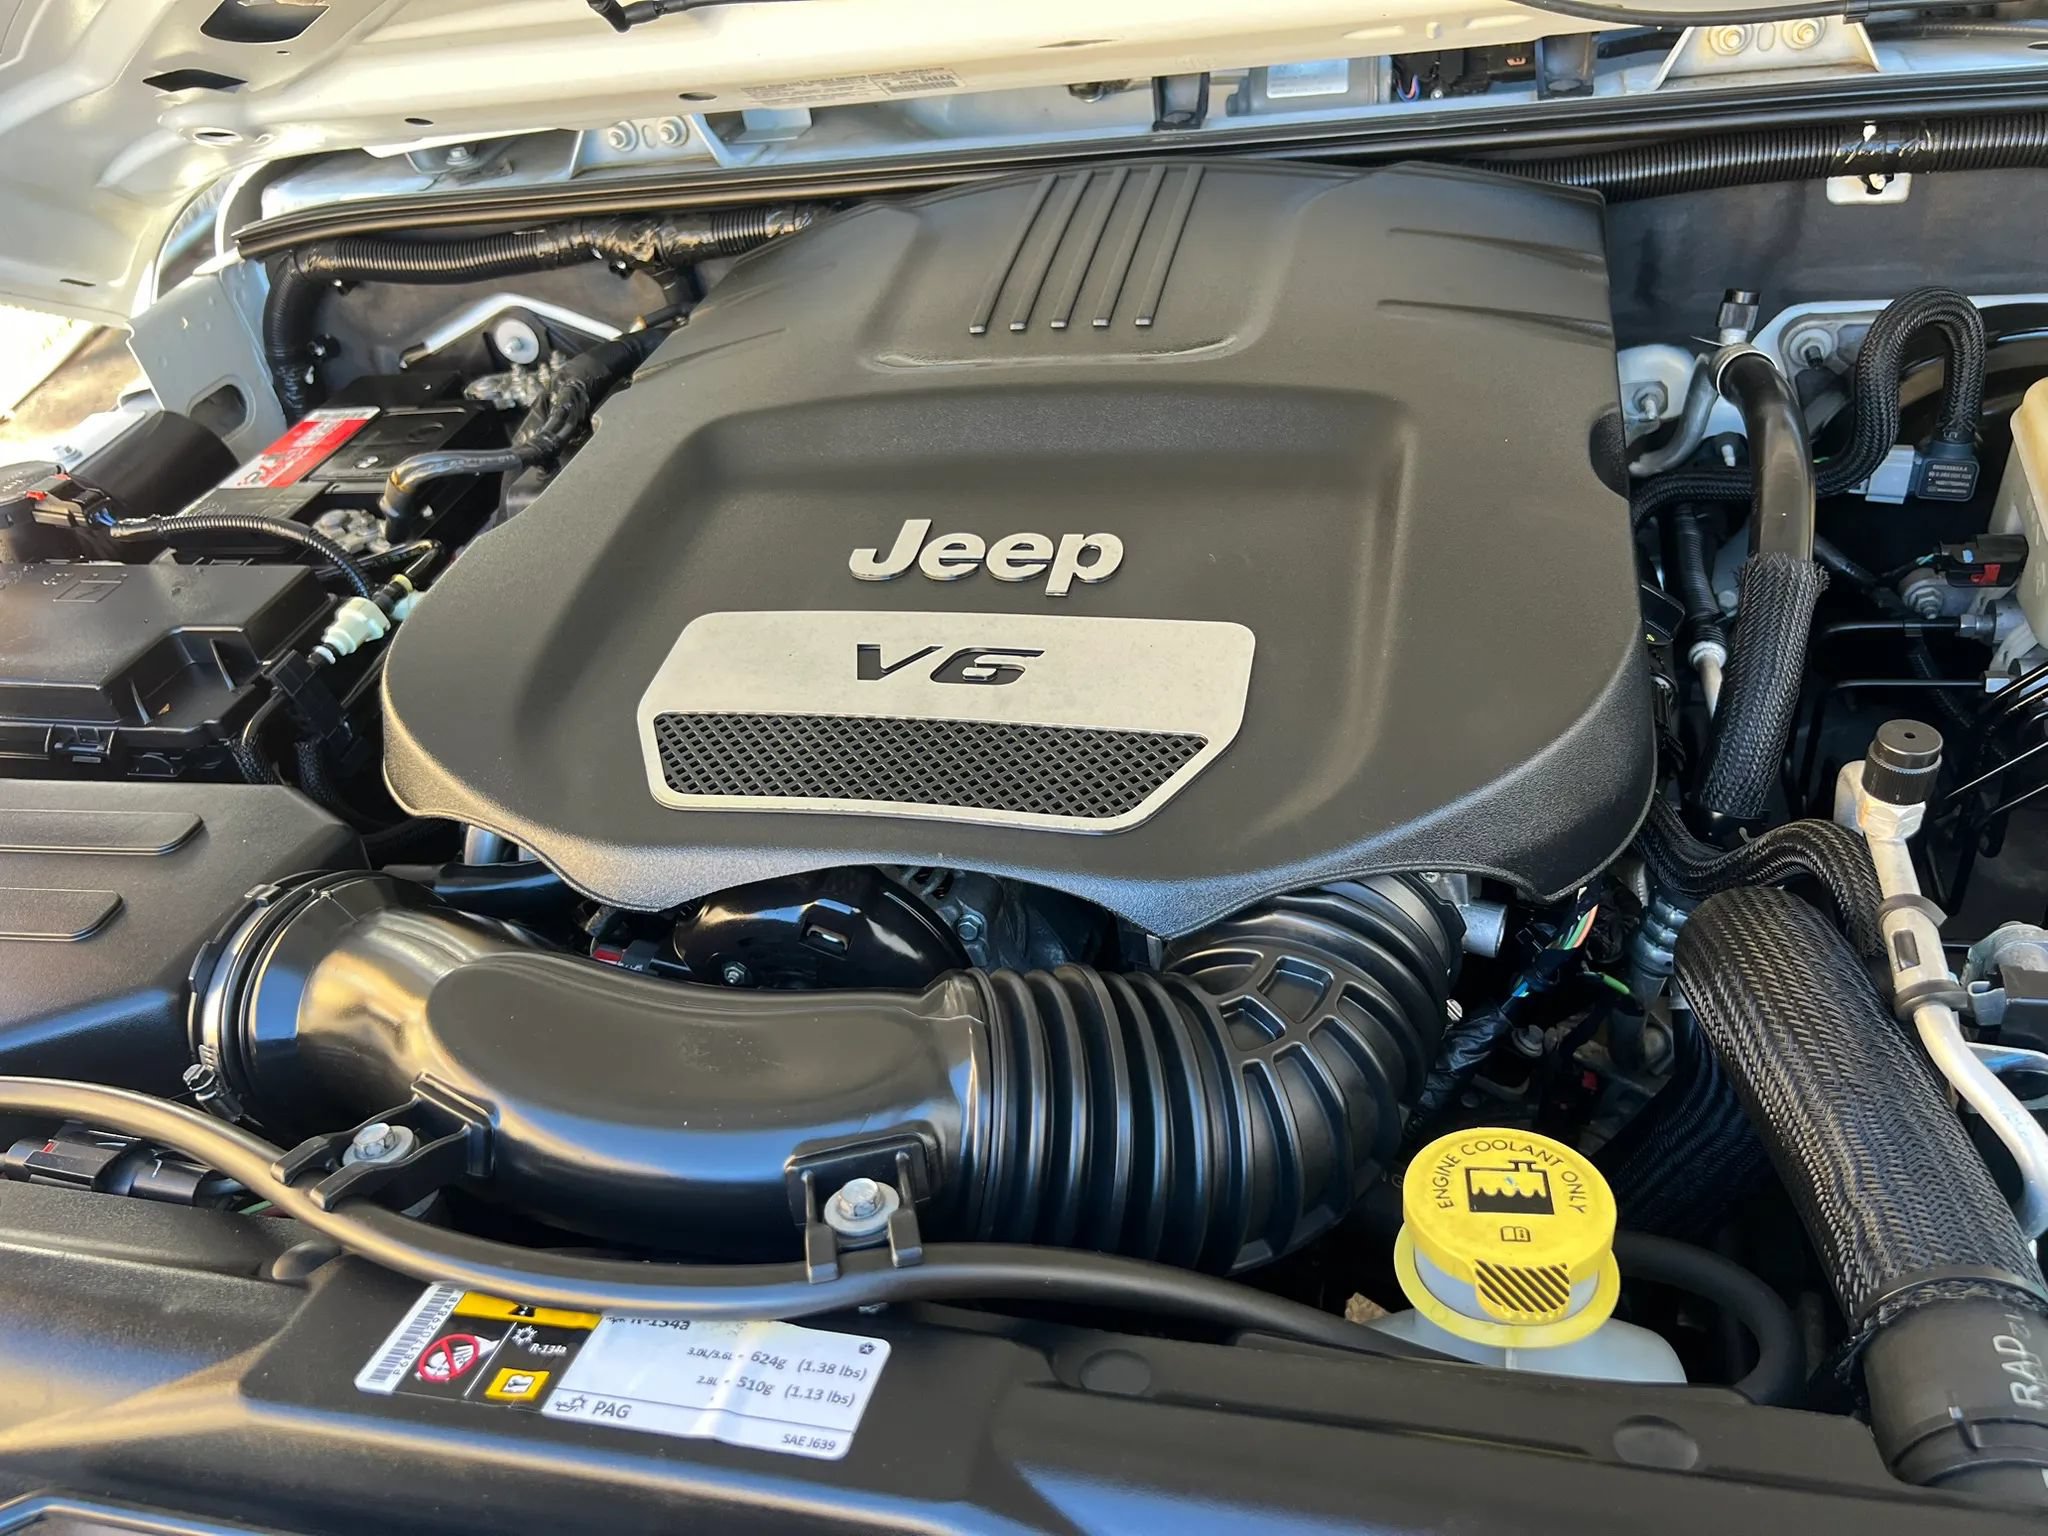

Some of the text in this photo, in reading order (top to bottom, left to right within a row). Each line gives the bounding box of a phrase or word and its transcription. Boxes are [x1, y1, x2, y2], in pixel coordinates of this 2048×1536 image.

[848, 518, 1125, 597] Jeep
[856, 643, 1045, 686] V6
[1431, 1152, 1461, 1211] ENGINE
[1460, 1138, 1565, 1168] COOLANT
[1560, 1170, 1588, 1215] ONLY
[528, 1342, 568, 1355] R-134a
[686, 1346, 734, 1361] 3.0L/3.6L
[750, 1350, 788, 1371] 624g
[796, 1358, 838, 1376] (1.38
[838, 1363, 868, 1382] lbs)
[1992, 1334, 2047, 1410] RAD
[695, 1374, 719, 1387] 2.8L
[735, 1375, 776, 1397] 510g
[783, 1383, 825, 1402] (1.13
[825, 1389, 856, 1409] lbs)
[591, 1400, 633, 1420] PAG
[781, 1432, 837, 1451] SAE J639
